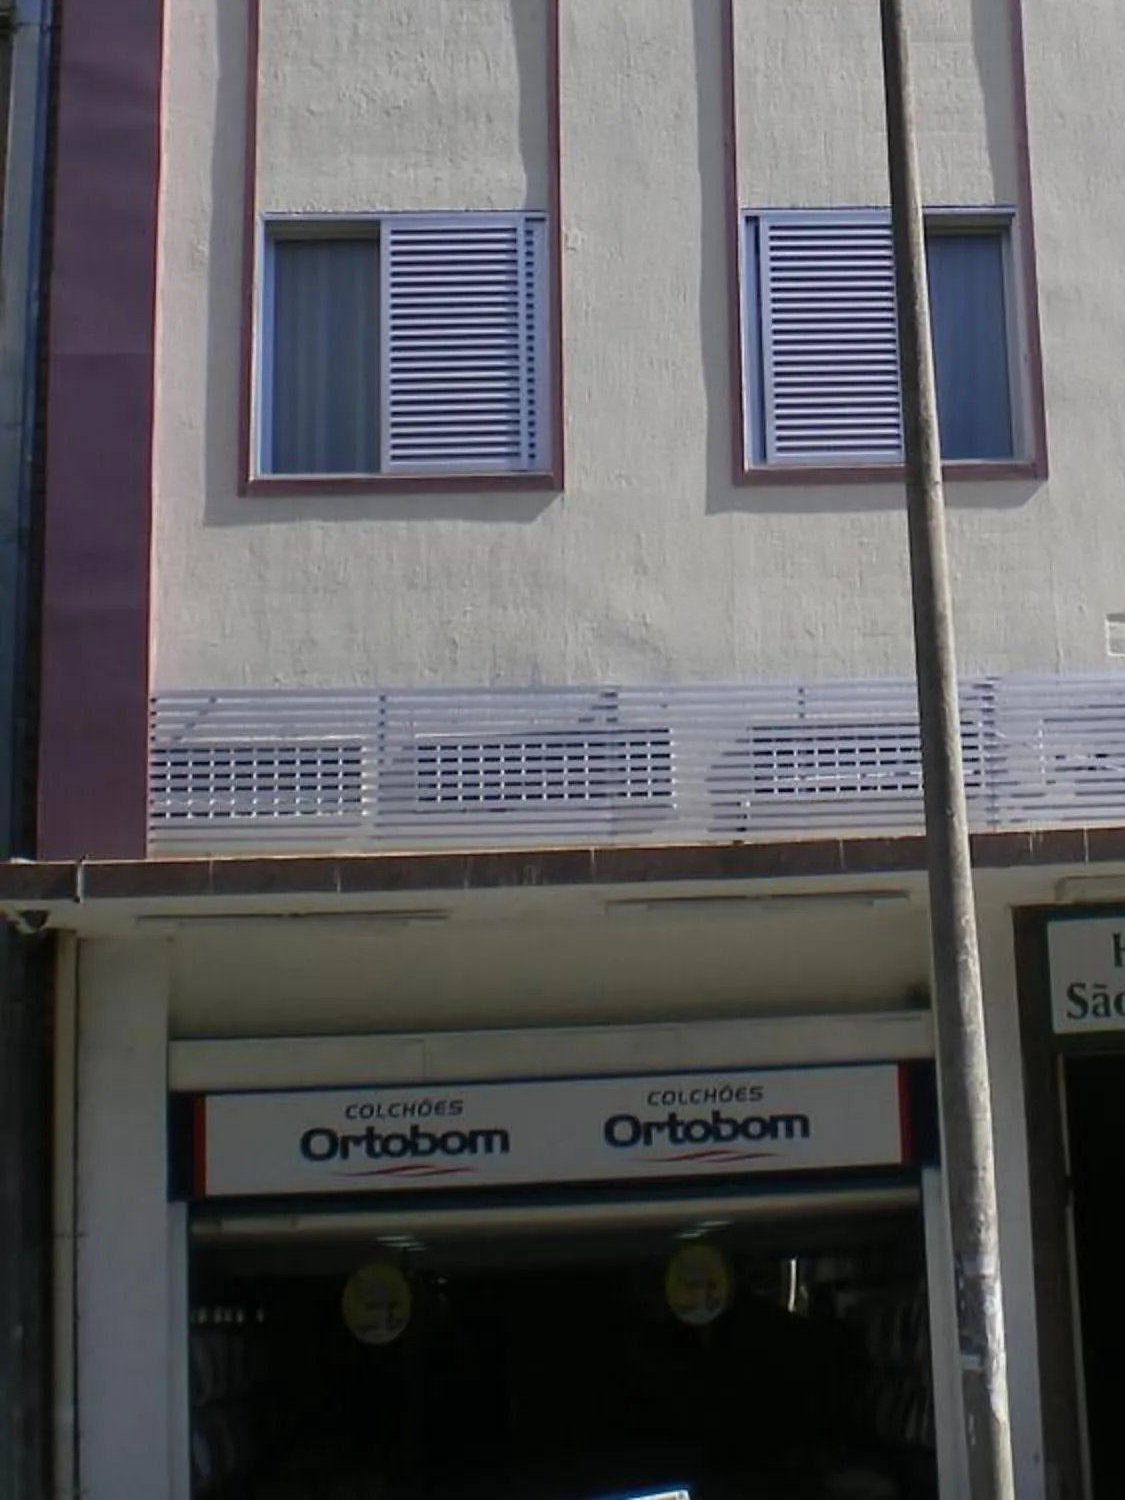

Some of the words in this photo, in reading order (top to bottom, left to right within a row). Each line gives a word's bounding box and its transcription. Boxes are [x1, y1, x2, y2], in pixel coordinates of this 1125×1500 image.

[344, 1098, 464, 1120] COLCHÕES
[646, 1084, 764, 1107] COLCHÕES
[300, 1123, 511, 1163] Ortobom
[603, 1110, 811, 1149] Ortobom
